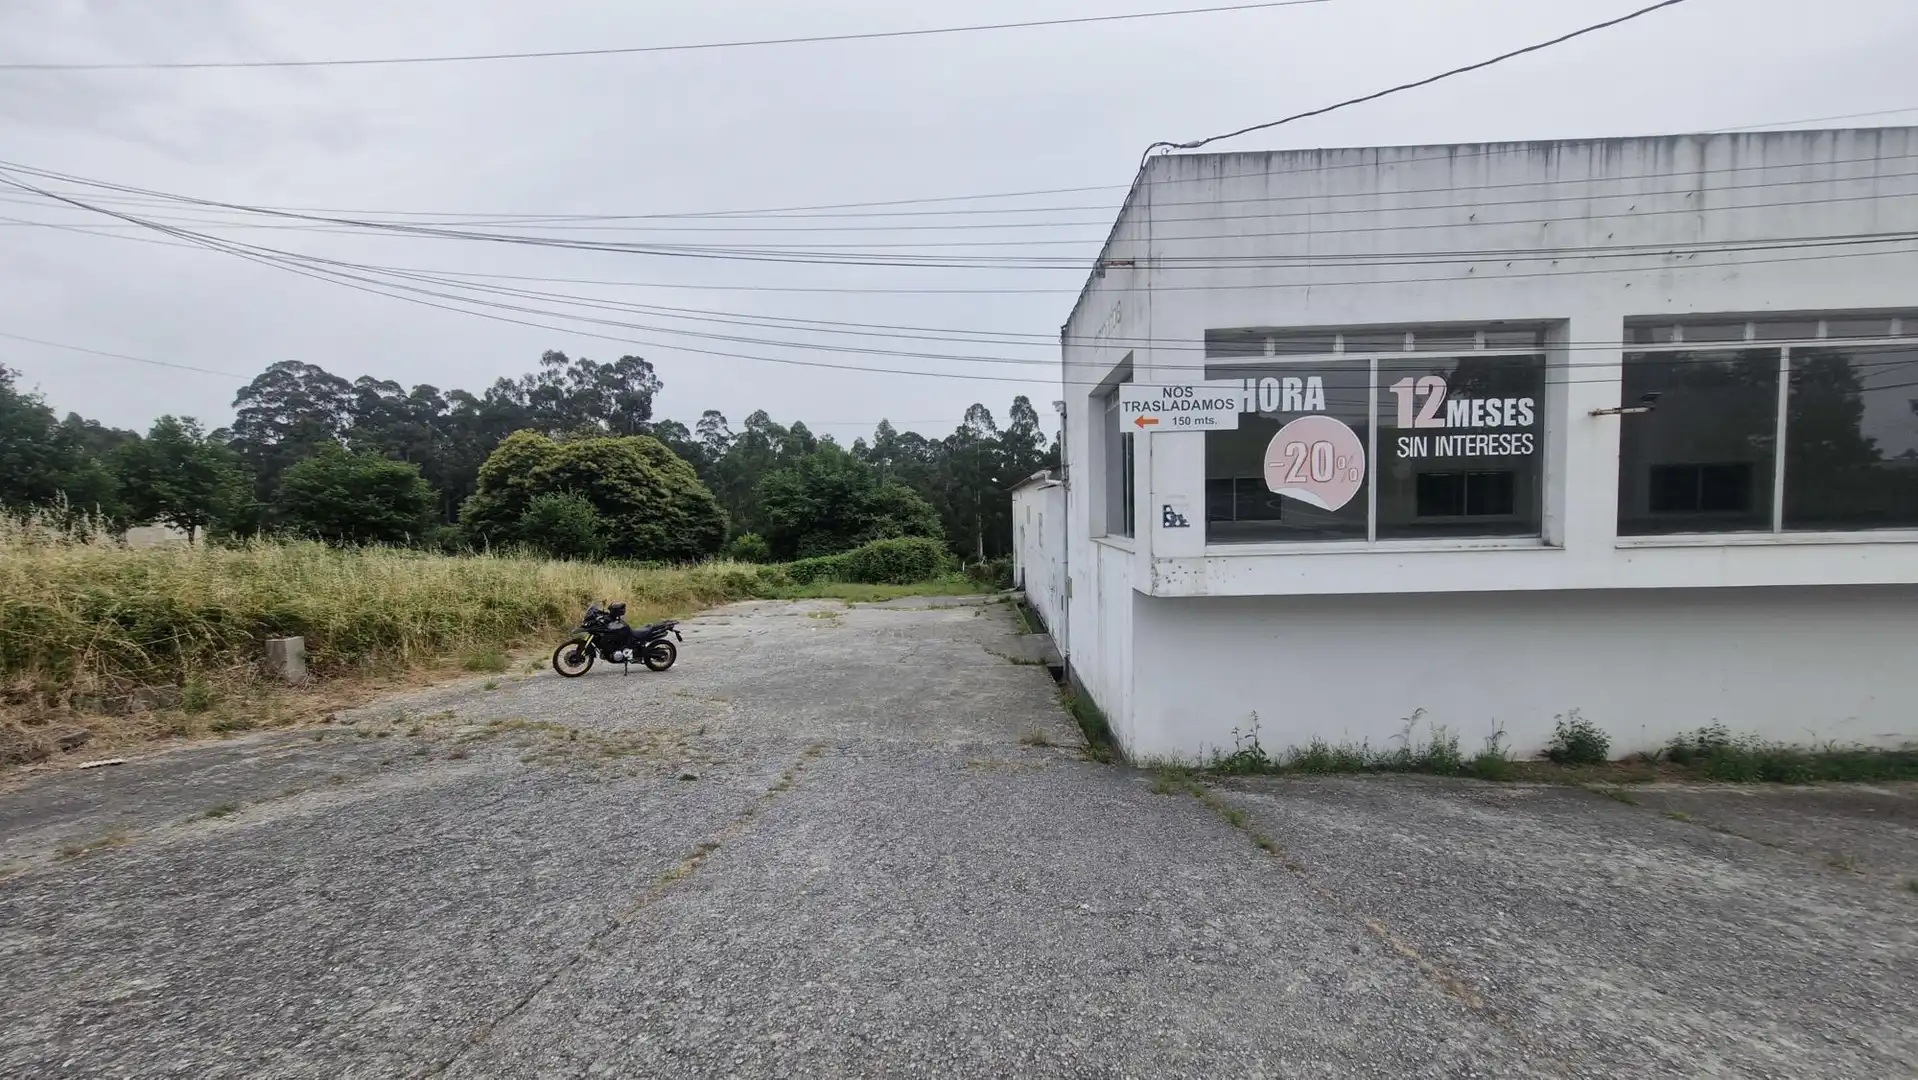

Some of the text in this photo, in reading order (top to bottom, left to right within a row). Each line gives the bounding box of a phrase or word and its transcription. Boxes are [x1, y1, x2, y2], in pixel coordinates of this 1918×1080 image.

[1162, 386, 1194, 398] NOS
[1238, 376, 1326, 412] HORA
[1389, 375, 1535, 428] 12 MESES
[1123, 399, 1235, 412] TRASLADAMOS
[1172, 416, 1218, 426] 150 mts.
[1397, 433, 1534, 458] SIN INTERESES
[1268, 440, 1359, 483] -20%
